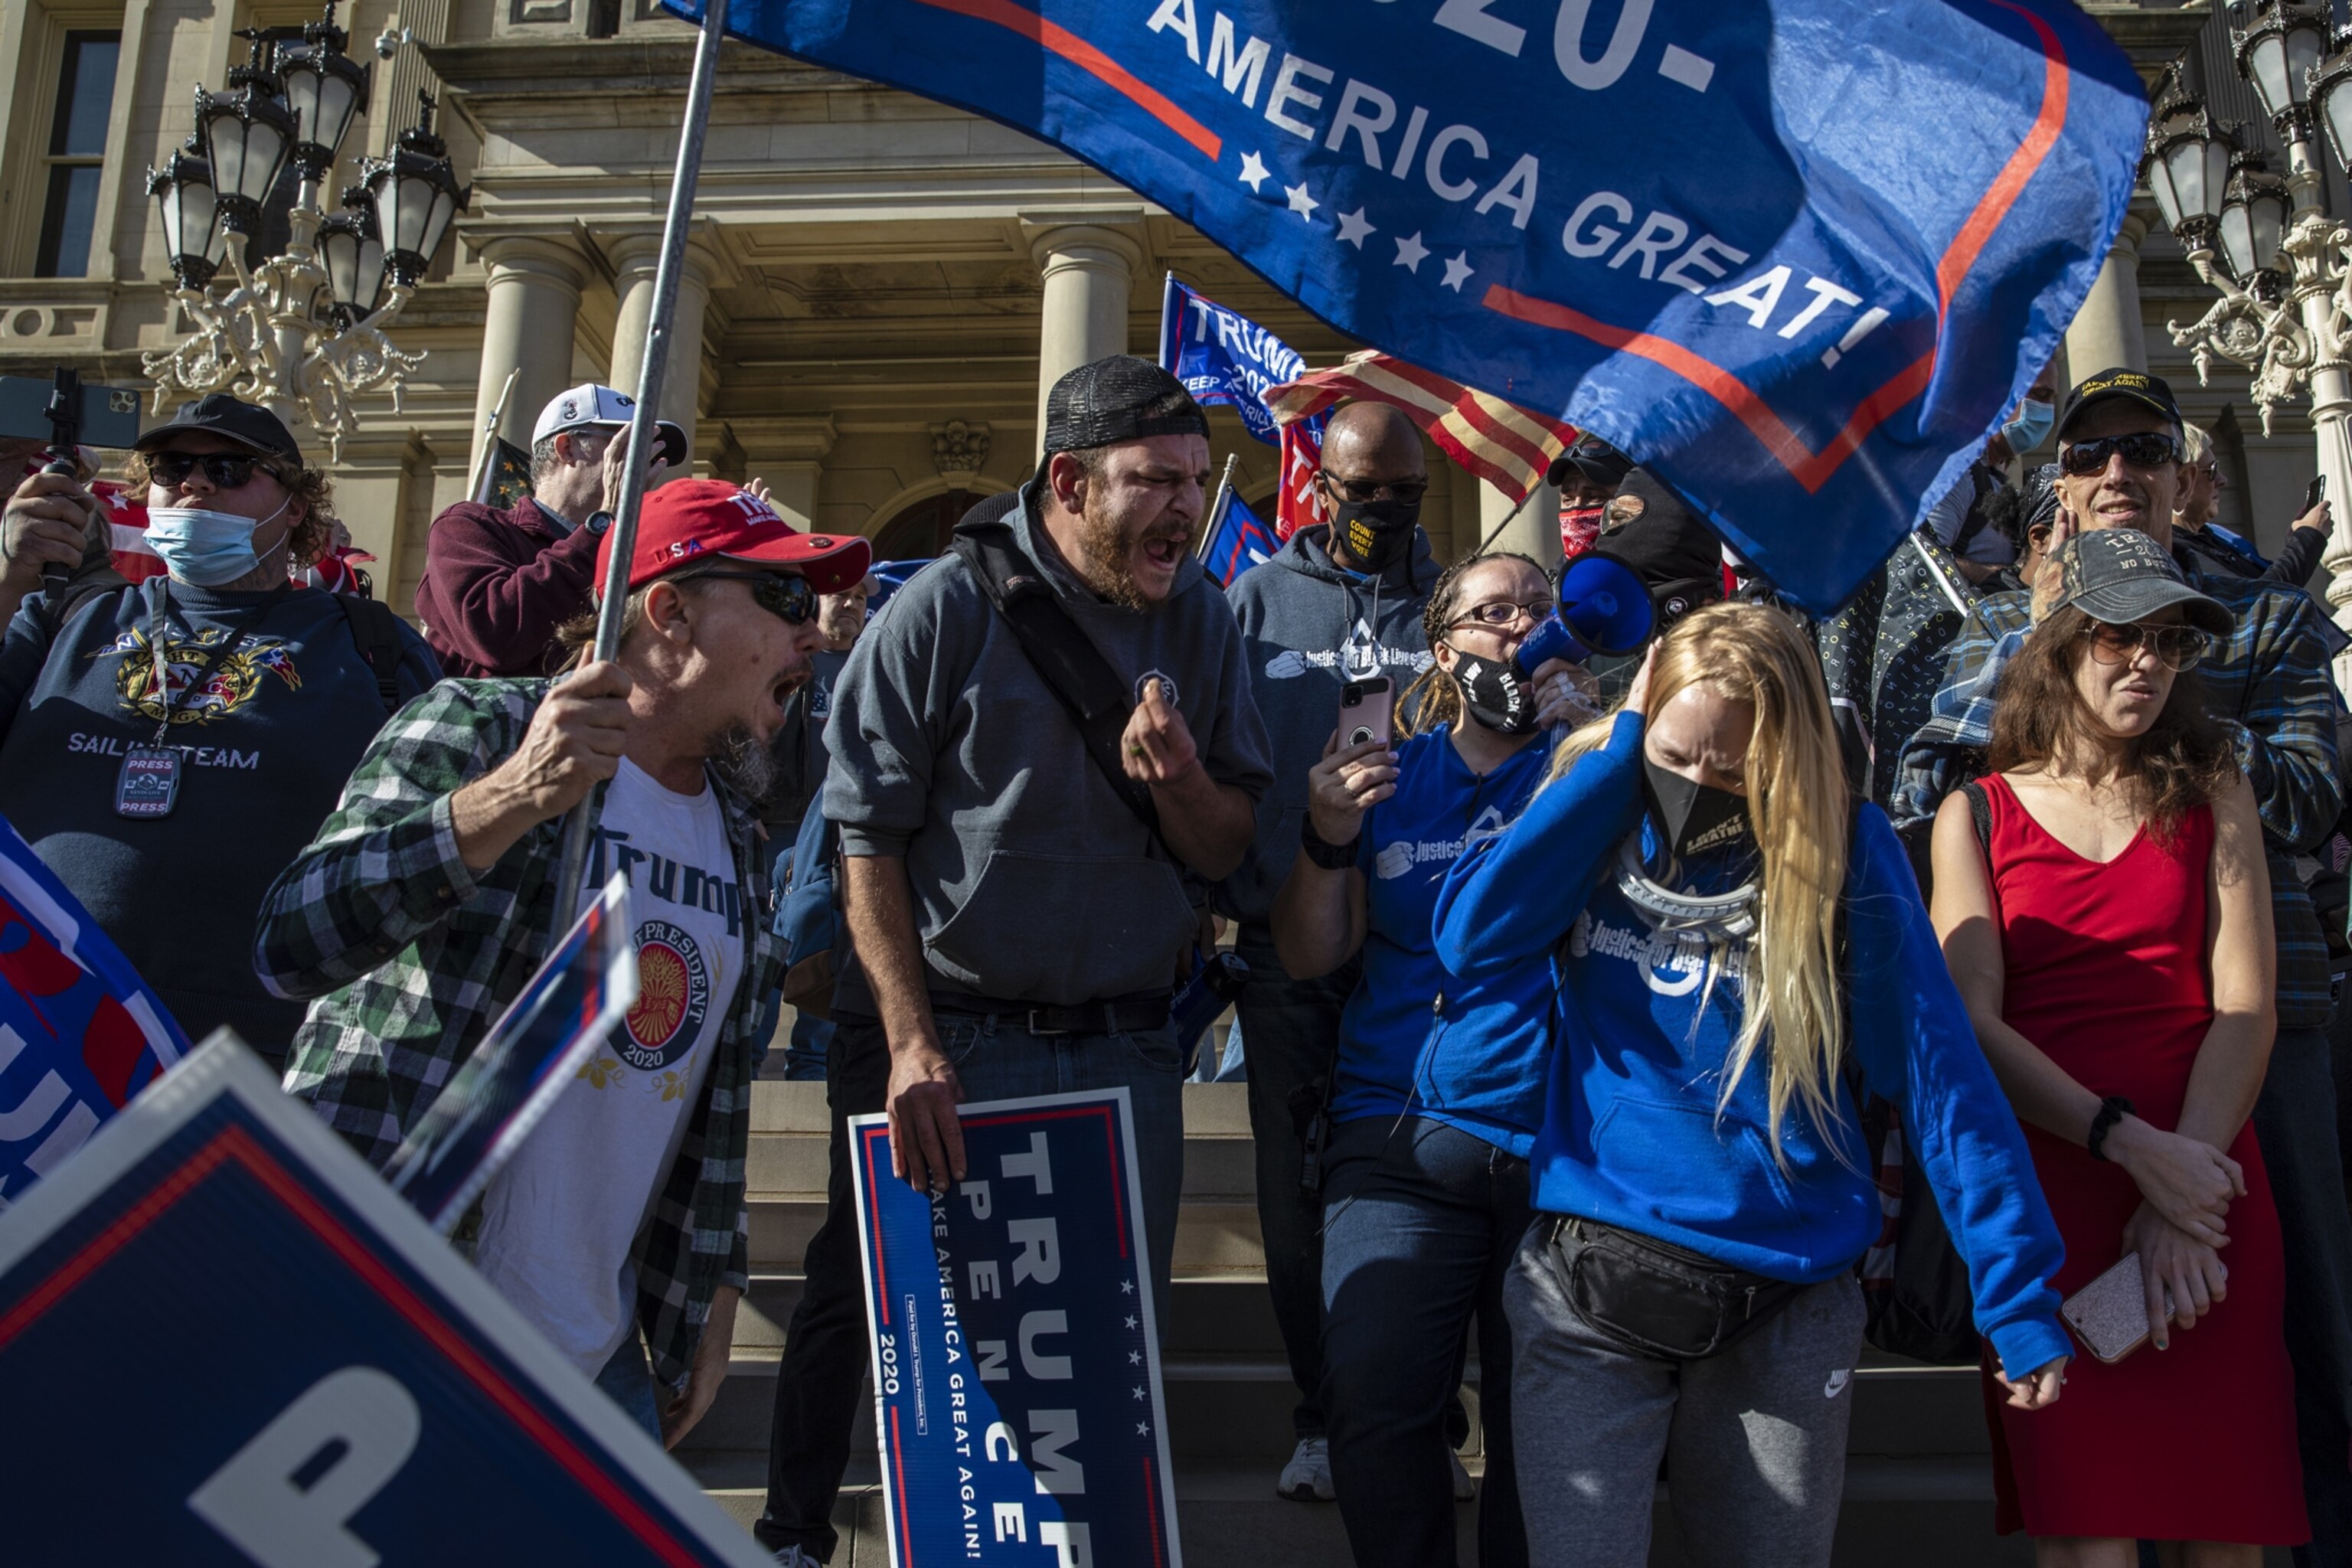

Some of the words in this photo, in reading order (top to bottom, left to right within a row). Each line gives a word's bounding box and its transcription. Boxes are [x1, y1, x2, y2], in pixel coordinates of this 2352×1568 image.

[1373, 0, 1715, 93] 20-
[1146, 0, 1539, 230] AMERICA
[1563, 191, 1890, 371] GREAT!
[1223, 364, 1276, 406] -202
[1349, 530, 1373, 547] EVERY
[1350, 519, 1376, 540] COUNT
[1351, 541, 1369, 557] VOTE
[654, 539, 703, 566] USA
[1305, 649, 1344, 669] Justice
[1498, 672, 1521, 713] BLACK
[128, 760, 174, 769] PRESS
[176, 744, 260, 769] TEAM
[119, 802, 167, 812] PRESS
[1416, 839, 1465, 864] Justice
[1590, 919, 1648, 963] Justice
[645, 923, 707, 1024] PRESIDENT
[622, 1044, 664, 1068] 2020
[928, 1170, 949, 1238] AKE
[936, 1247, 962, 1364] AMERICA
[910, 1323, 916, 1331] by
[880, 1334, 900, 1395] 2020
[960, 1180, 1027, 1543] PENCE
[1001, 1131, 1094, 1568] TRUMP
[949, 1374, 971, 1458] GREAT
[958, 1466, 982, 1559] AGAIN!
